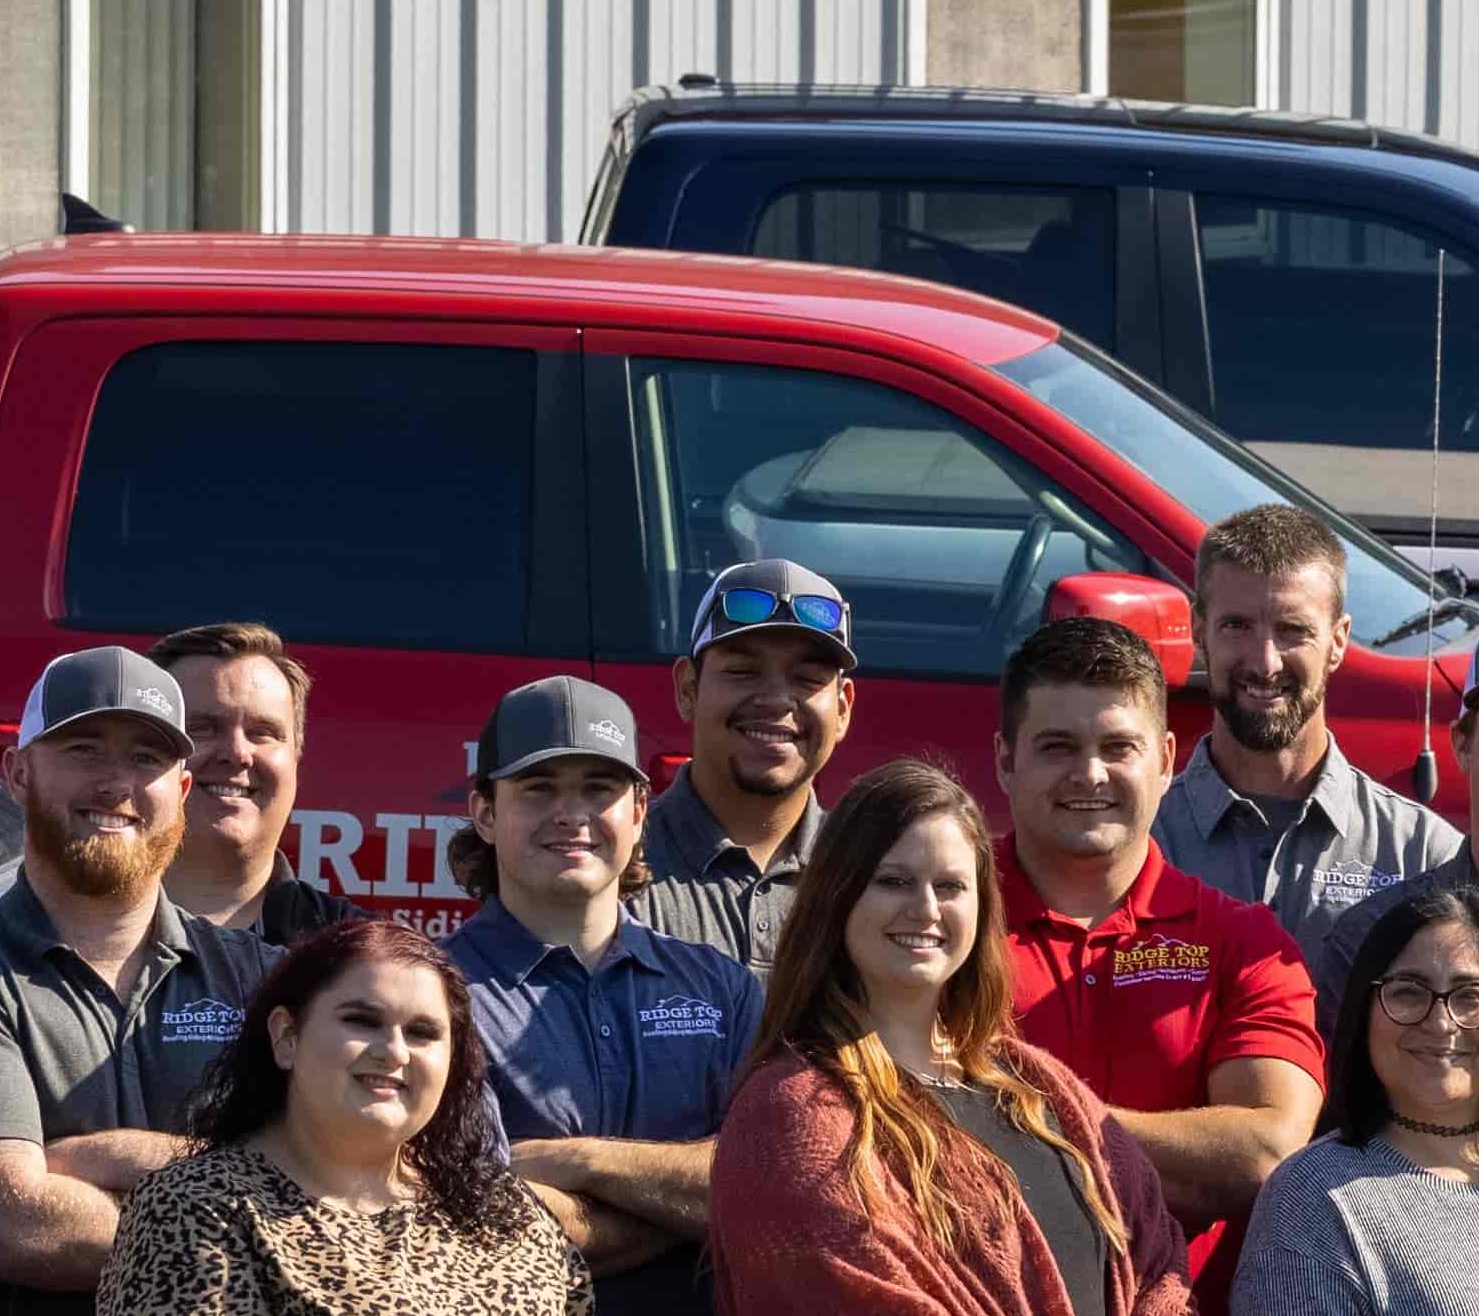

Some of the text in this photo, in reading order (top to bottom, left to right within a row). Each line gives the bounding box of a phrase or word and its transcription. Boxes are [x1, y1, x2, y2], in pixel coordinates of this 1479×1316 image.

[1312, 868, 1366, 886] RIDGE
[1114, 945, 1210, 964] RIDGE TOP
[1114, 956, 1210, 974] EXTERIORS
[162, 1011, 217, 1024] RIDGE
[639, 1005, 722, 1022] RIDGE TOP
